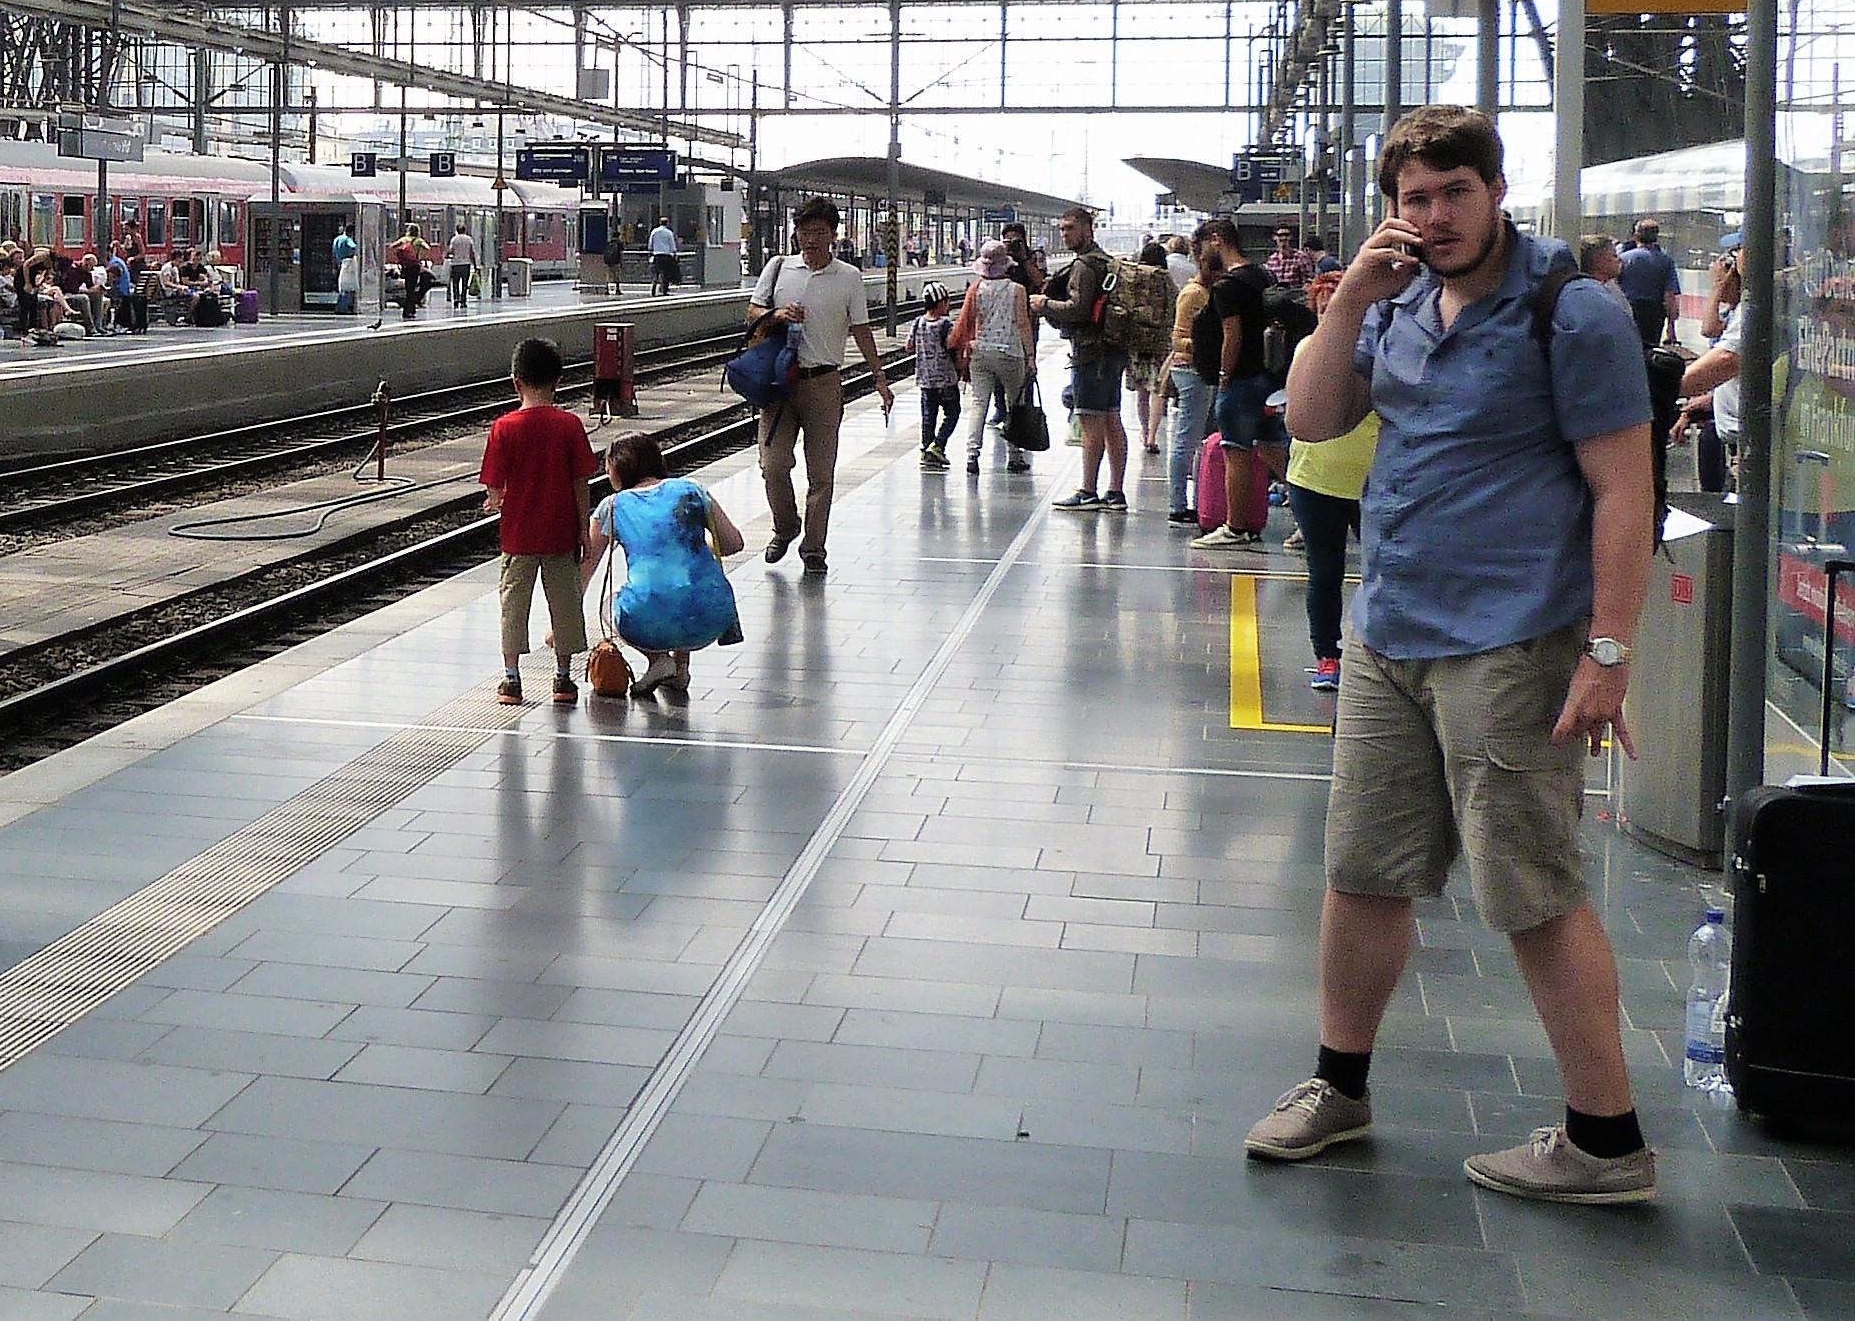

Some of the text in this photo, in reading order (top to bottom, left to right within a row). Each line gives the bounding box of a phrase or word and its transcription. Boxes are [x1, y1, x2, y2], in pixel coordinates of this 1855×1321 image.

[354, 153, 367, 172] B
[437, 153, 451, 172] B
[1237, 161, 1251, 180] B
